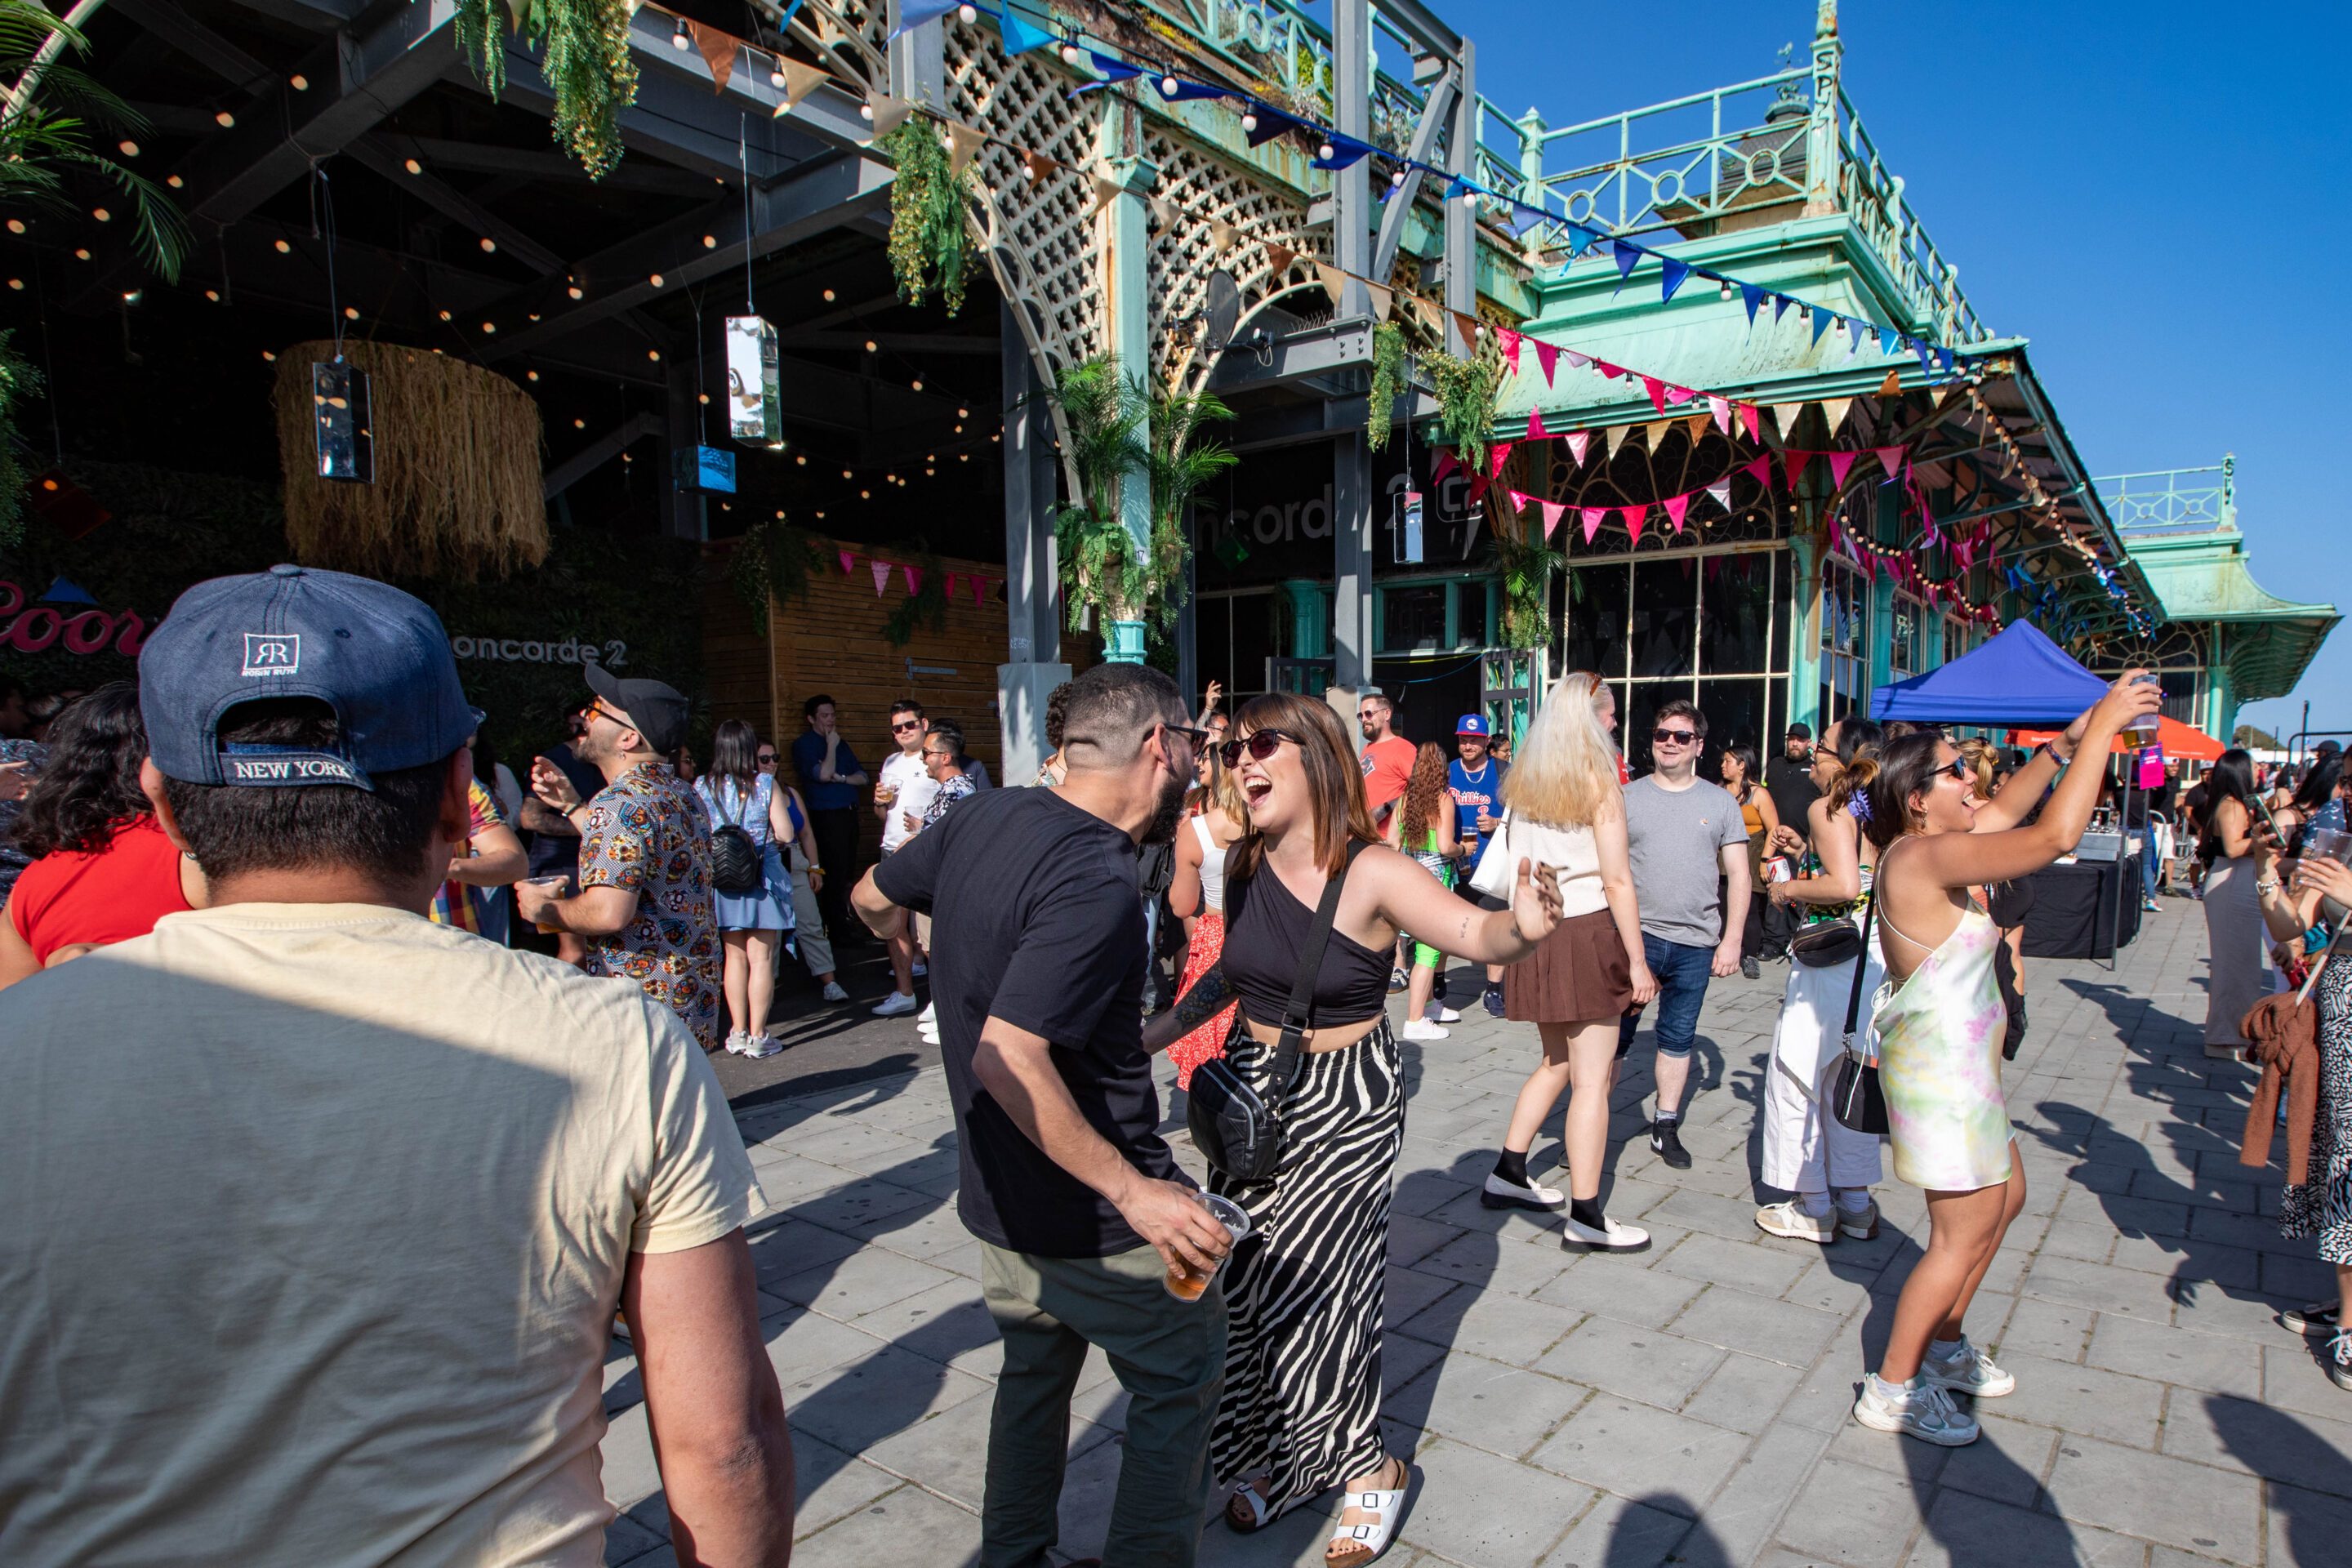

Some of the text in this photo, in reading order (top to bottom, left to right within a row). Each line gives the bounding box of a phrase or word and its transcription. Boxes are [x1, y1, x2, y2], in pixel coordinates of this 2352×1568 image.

[451, 635, 628, 666] oncorde 2
[273, 668, 298, 676] RUTH
[234, 760, 352, 779] NEW YORK
[1448, 786, 1491, 806] Phillies
[1477, 804, 1490, 816] P
